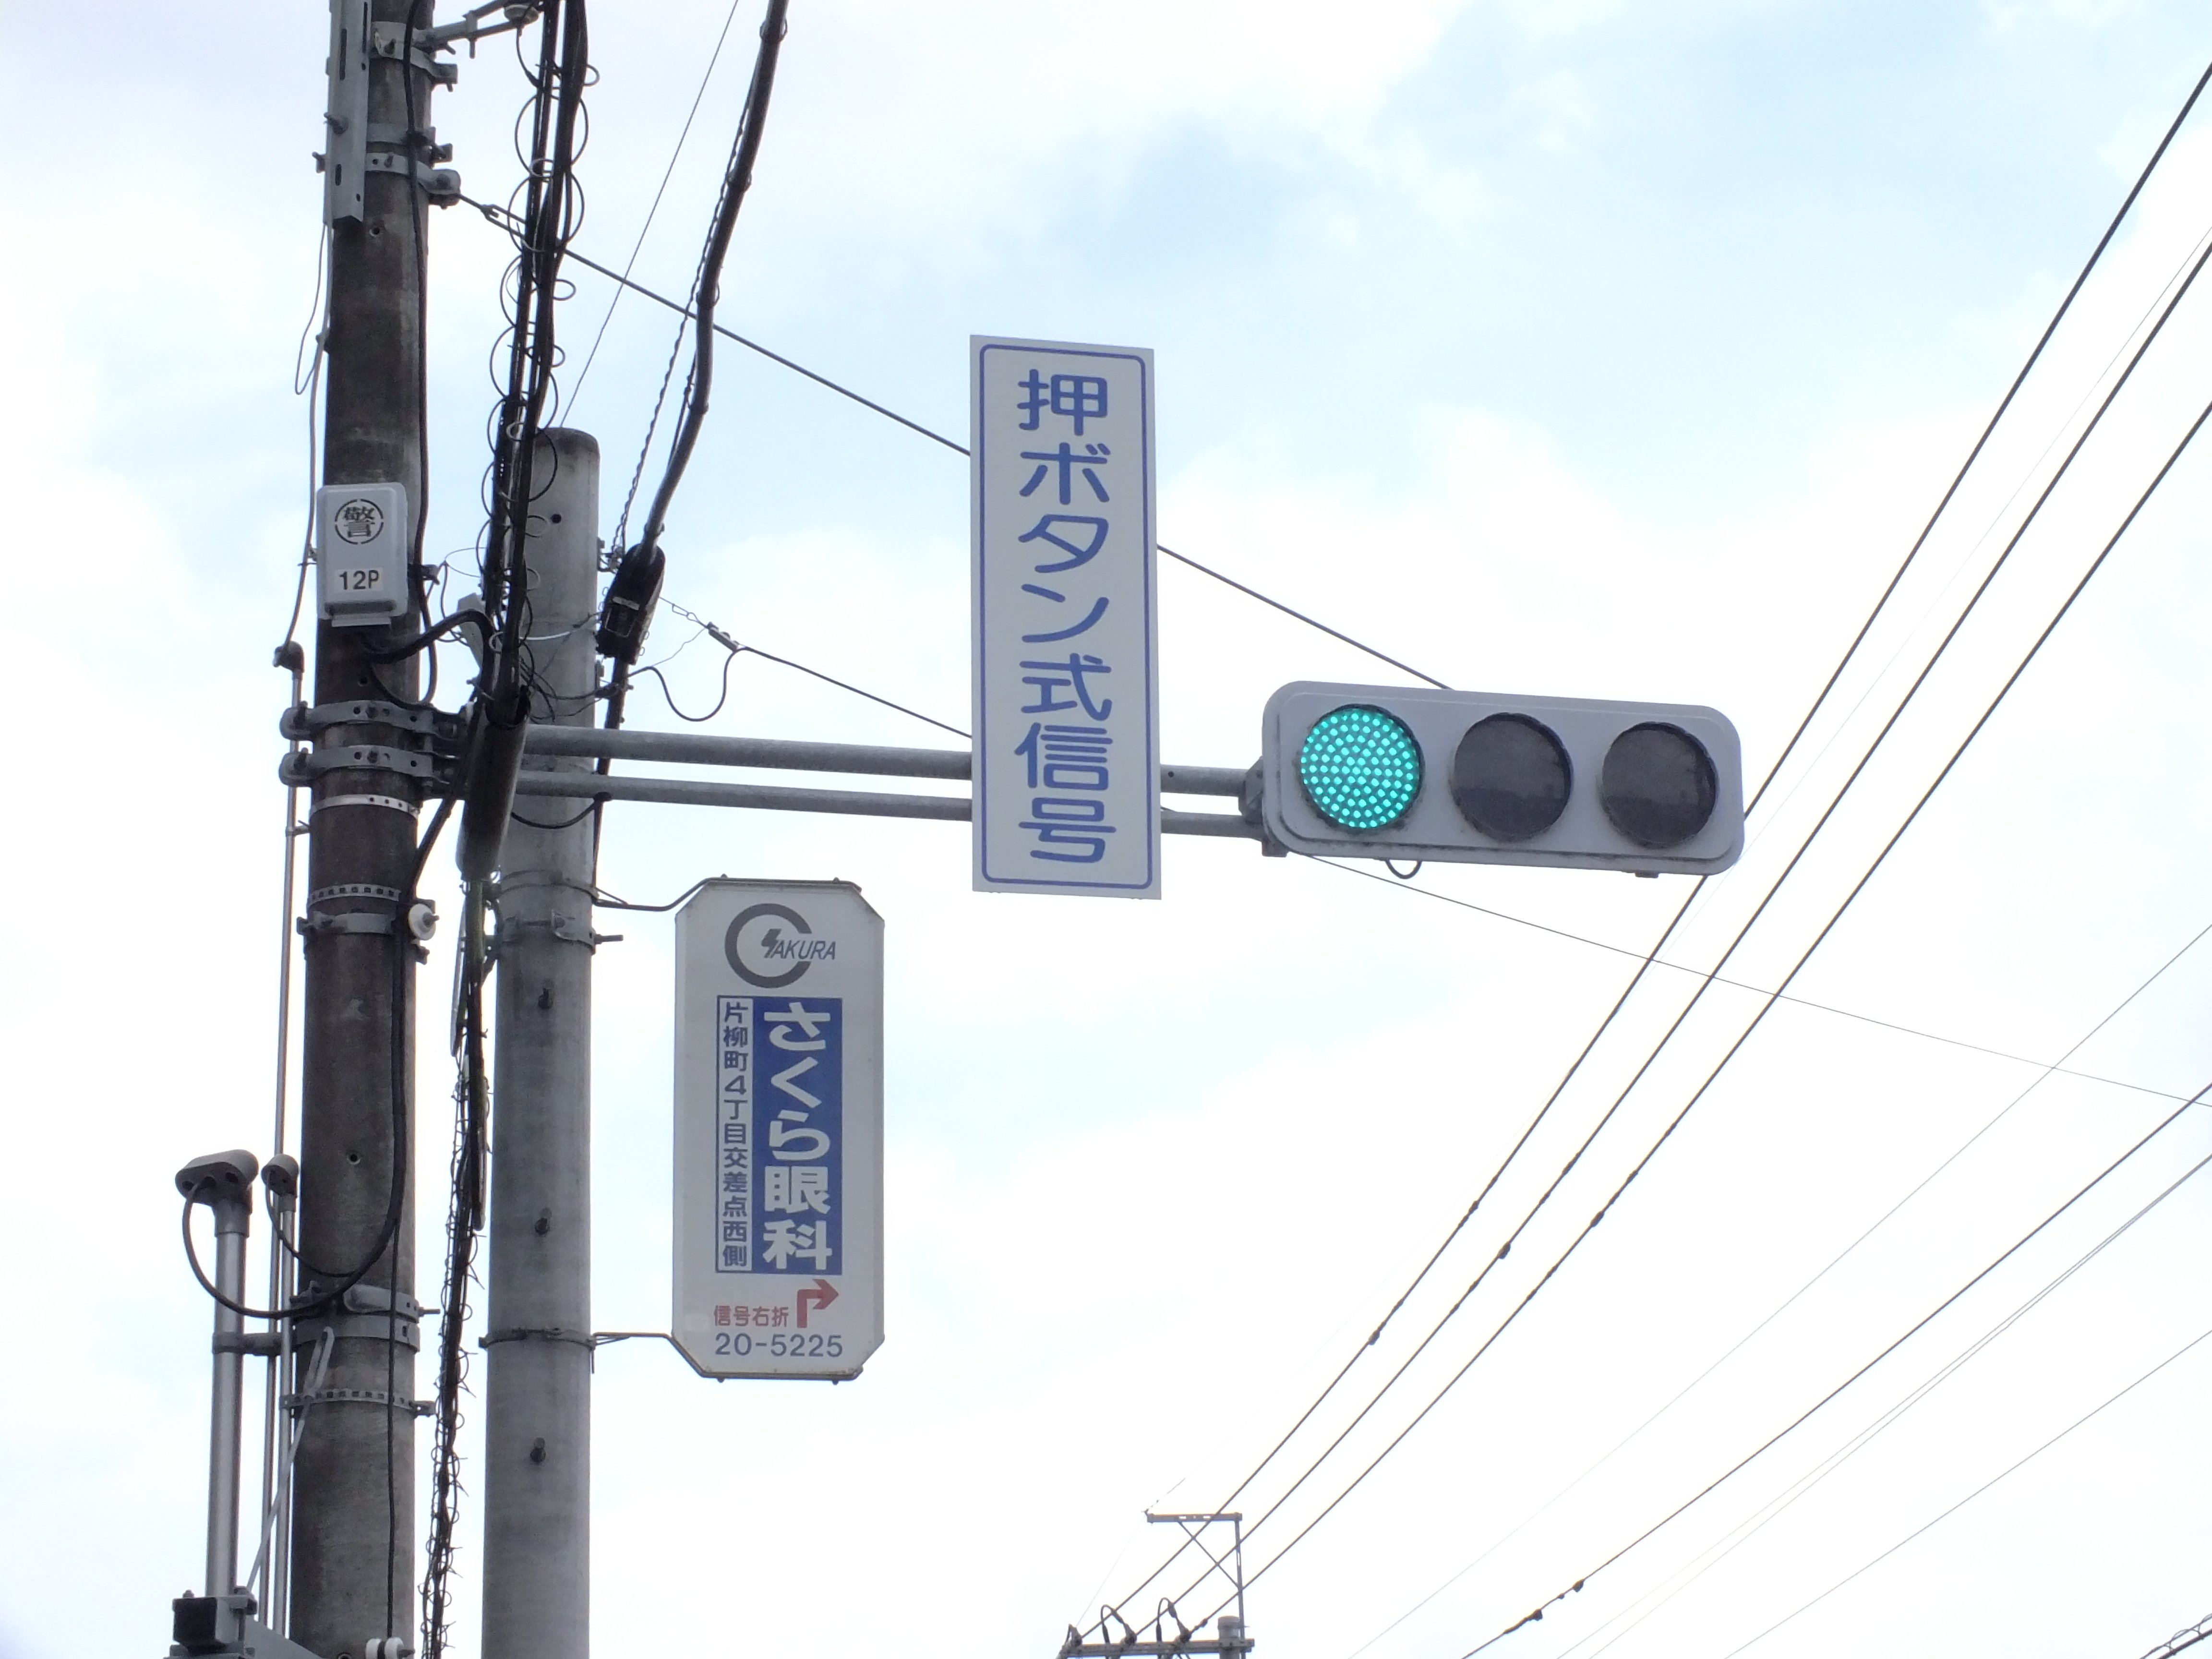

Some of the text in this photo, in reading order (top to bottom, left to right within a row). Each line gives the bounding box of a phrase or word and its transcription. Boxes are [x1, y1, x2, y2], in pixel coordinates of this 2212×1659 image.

[343, 506, 375, 538] 警
[339, 569, 379, 590] 12P
[1014, 368, 1117, 863] 押ボタン式信号
[761, 928, 836, 960] SAKURA
[722, 1001, 748, 1267] 片柳町4丁目交差点西側
[762, 1001, 833, 1271] さくら眼科
[714, 1305, 789, 1328] 信号右折
[715, 1333, 843, 1358] 20-5225
